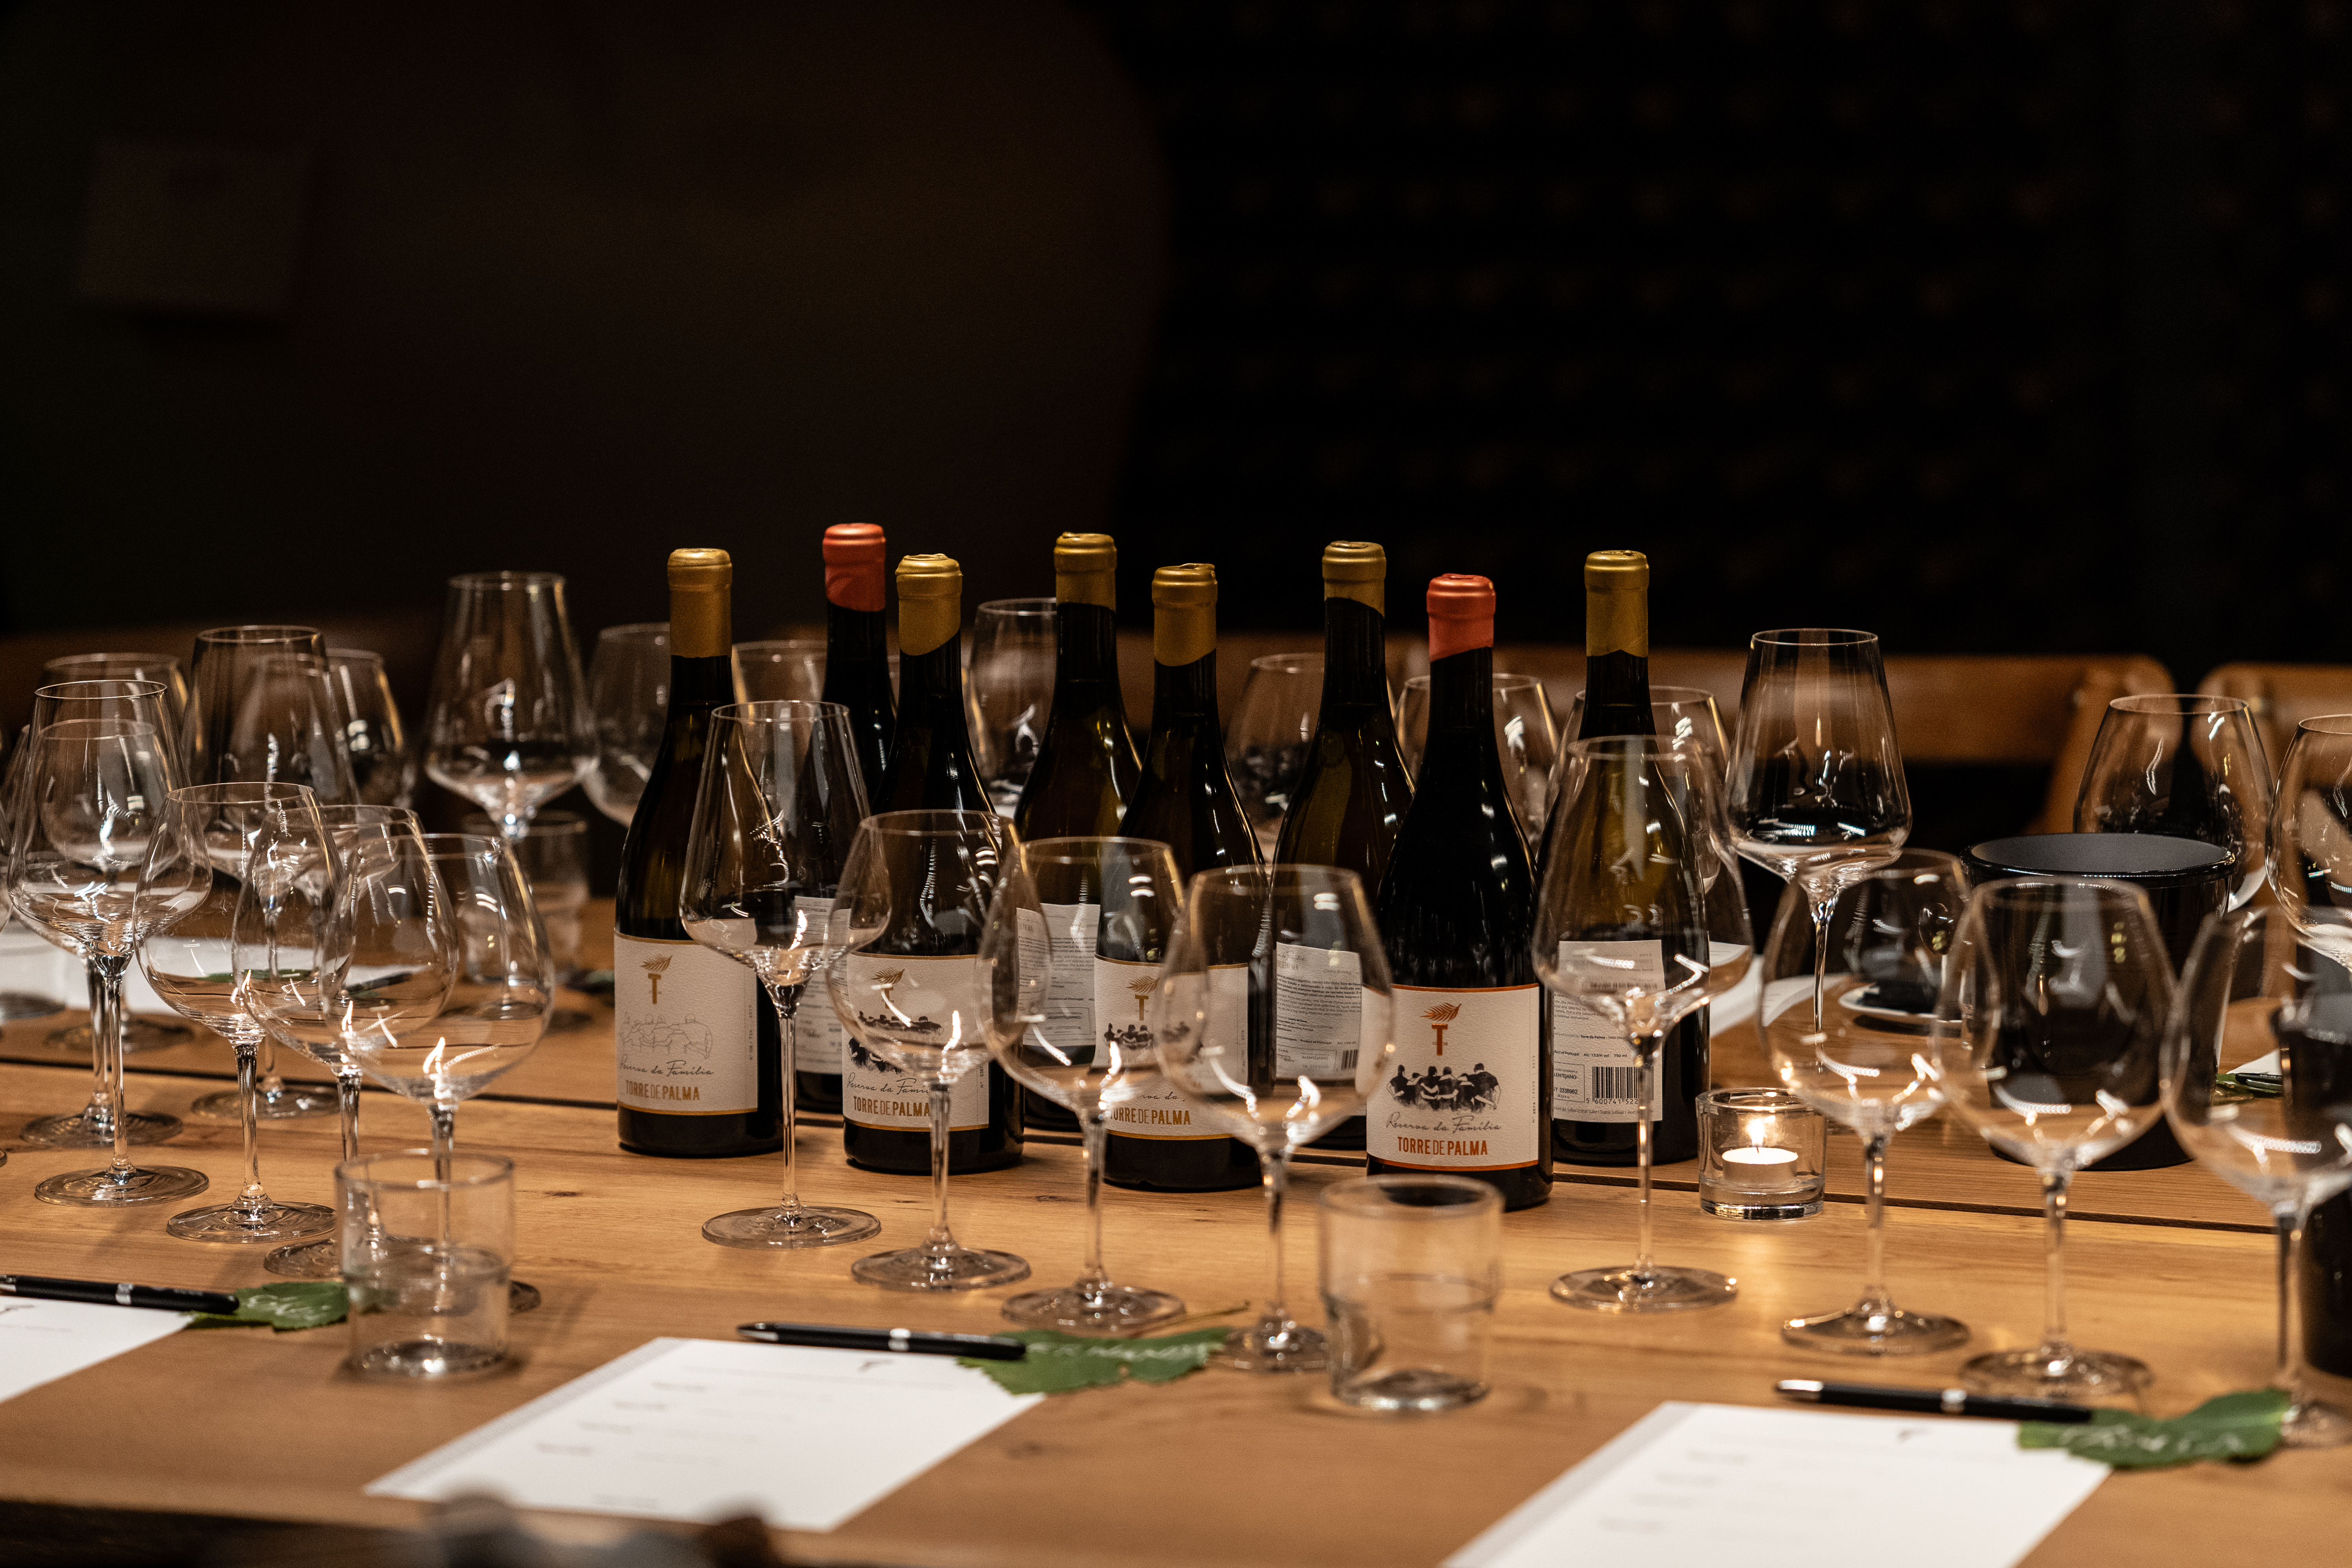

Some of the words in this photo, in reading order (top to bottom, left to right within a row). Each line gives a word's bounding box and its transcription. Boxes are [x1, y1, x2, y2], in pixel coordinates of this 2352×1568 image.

[648, 973, 661, 1004] T
[1135, 994, 1149, 1021] T
[1432, 1023, 1448, 1056] T
[651, 1065, 663, 1074] da
[666, 1060, 714, 1077] Família
[662, 1085, 700, 1101] PALMA
[847, 1072, 877, 1091] Reserva
[880, 1083, 893, 1092] da
[896, 1078, 929, 1095] Famí
[853, 1096, 878, 1114] TORRE
[893, 1102, 931, 1117] PALMA
[1165, 1092, 1179, 1100] da
[1151, 1110, 1191, 1125] PALMA
[1386, 1112, 1430, 1130] Reserva
[1434, 1122, 1450, 1131] da
[1451, 1116, 1502, 1134] Família
[1397, 1136, 1430, 1154] TORRE
[1433, 1140, 1445, 1155] DE
[1447, 1140, 1488, 1156] PALMA
